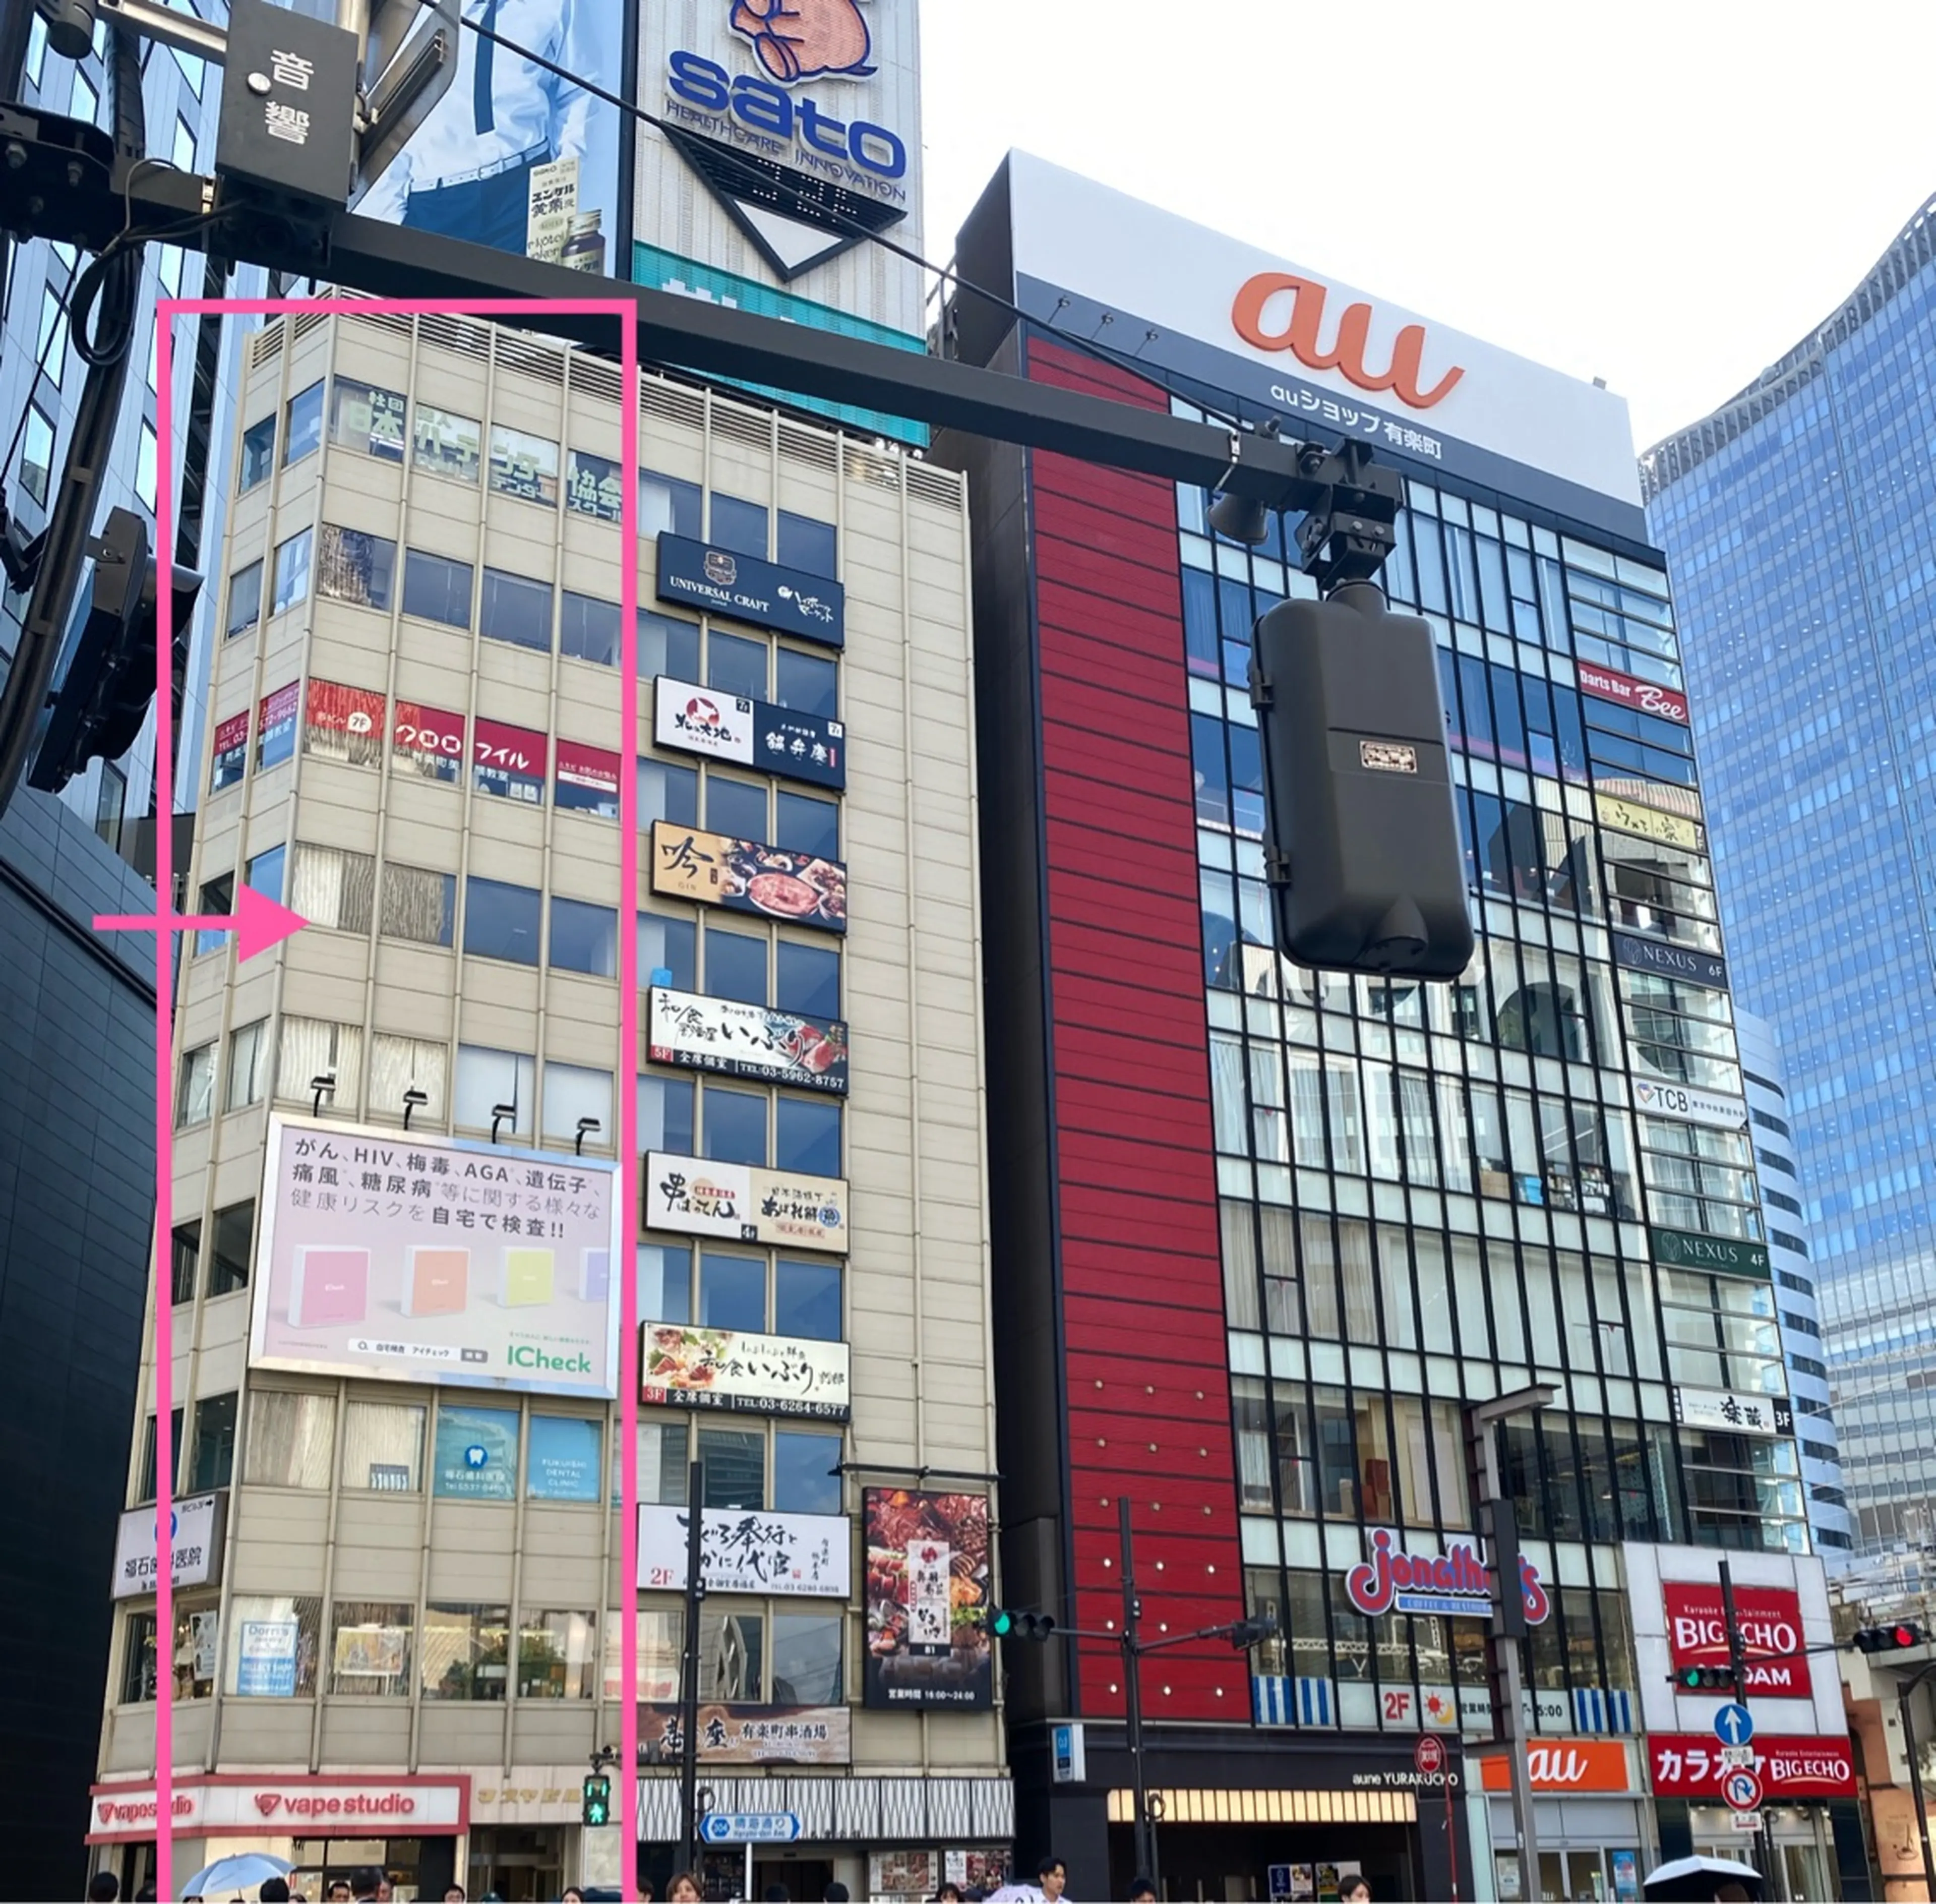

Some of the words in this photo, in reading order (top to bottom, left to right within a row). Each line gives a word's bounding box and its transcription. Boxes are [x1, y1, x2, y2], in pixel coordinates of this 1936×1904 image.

[265, 49, 314, 145] 音響
[669, 50, 906, 178] sato
[666, 100, 786, 154] HEALTHCARE
[795, 149, 906, 202] INNOVATION
[1231, 272, 1466, 409] au
[671, 576, 732, 602] UNIVERSAL
[735, 594, 769, 612] CRAFT
[1579, 669, 1610, 690] Darts
[1612, 679, 1631, 697] Bar
[1635, 685, 1685, 720] Bee
[1643, 945, 1697, 972] NEXUS
[1709, 966, 1722, 977] 6F
[680, 1051, 728, 1069] 全席個室
[1654, 1086, 1688, 1112] TCB
[1682, 1239, 1738, 1262] NEXUS
[1750, 1254, 1765, 1267] 4F
[507, 1345, 591, 1373] ICheck
[673, 1391, 723, 1406] 全席個室
[1777, 1411, 1791, 1427] 3F
[546, 1468, 581, 1478] DENTAL
[548, 1478, 580, 1488] CLINIC
[125, 1546, 202, 1578] 福石医院
[650, 1567, 674, 1585] 2F
[1683, 1604, 1718, 1615] Karaoke
[1675, 1618, 1725, 1650] BIG
[1732, 1622, 1797, 1653] CHO
[1384, 1692, 1410, 1720] 2F
[1528, 1748, 1588, 1782] au
[1775, 1749, 1798, 1757] Karaoke
[1799, 1750, 1839, 1758] Entertainment
[1353, 1773, 1381, 1786] aune
[1770, 1759, 1803, 1780] BIG
[1807, 1760, 1850, 1782] ECHO
